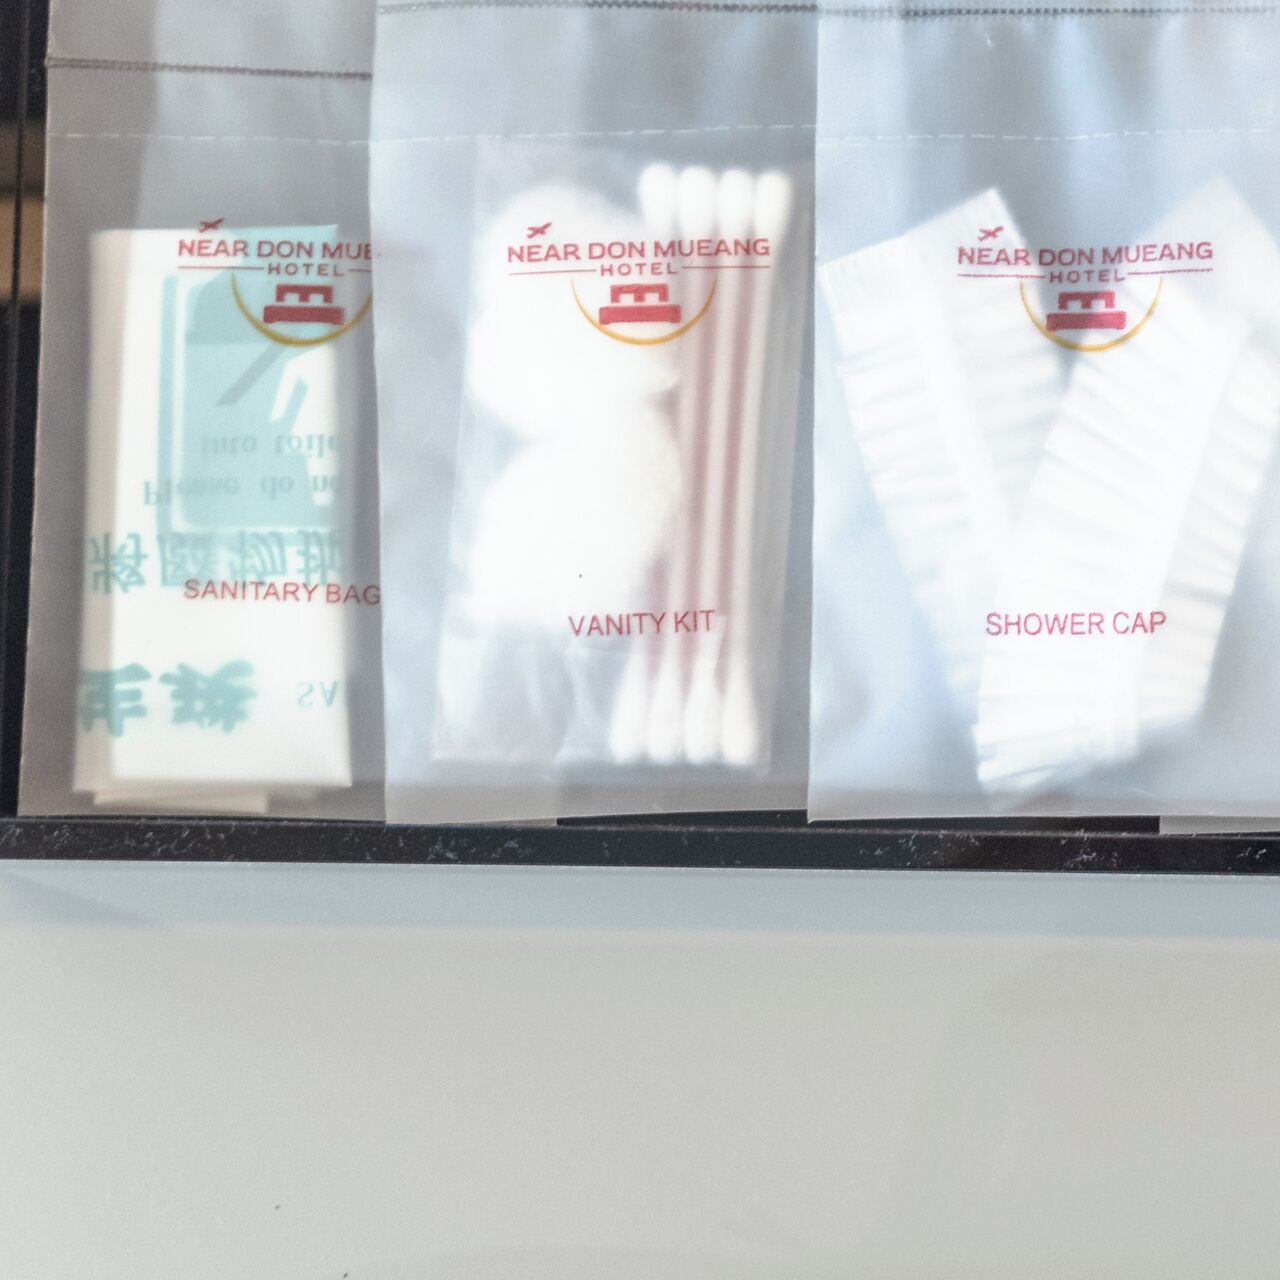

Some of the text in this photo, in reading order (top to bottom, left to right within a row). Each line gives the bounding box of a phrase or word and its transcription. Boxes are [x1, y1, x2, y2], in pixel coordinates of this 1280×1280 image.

[178, 239, 249, 259] NEAR
[256, 240, 313, 258] DON
[508, 238, 770, 263] NEAR DON MUEANG
[957, 241, 1214, 267] NEAR DON MUEANG
[266, 260, 347, 279] HOTEL
[600, 261, 678, 276] HOTEL
[1048, 268, 1125, 284] HOTEL
[184, 580, 381, 605] SANITARY BAG
[568, 610, 715, 636] VANITY KIT
[986, 611, 1166, 636] SHOWER CAP
